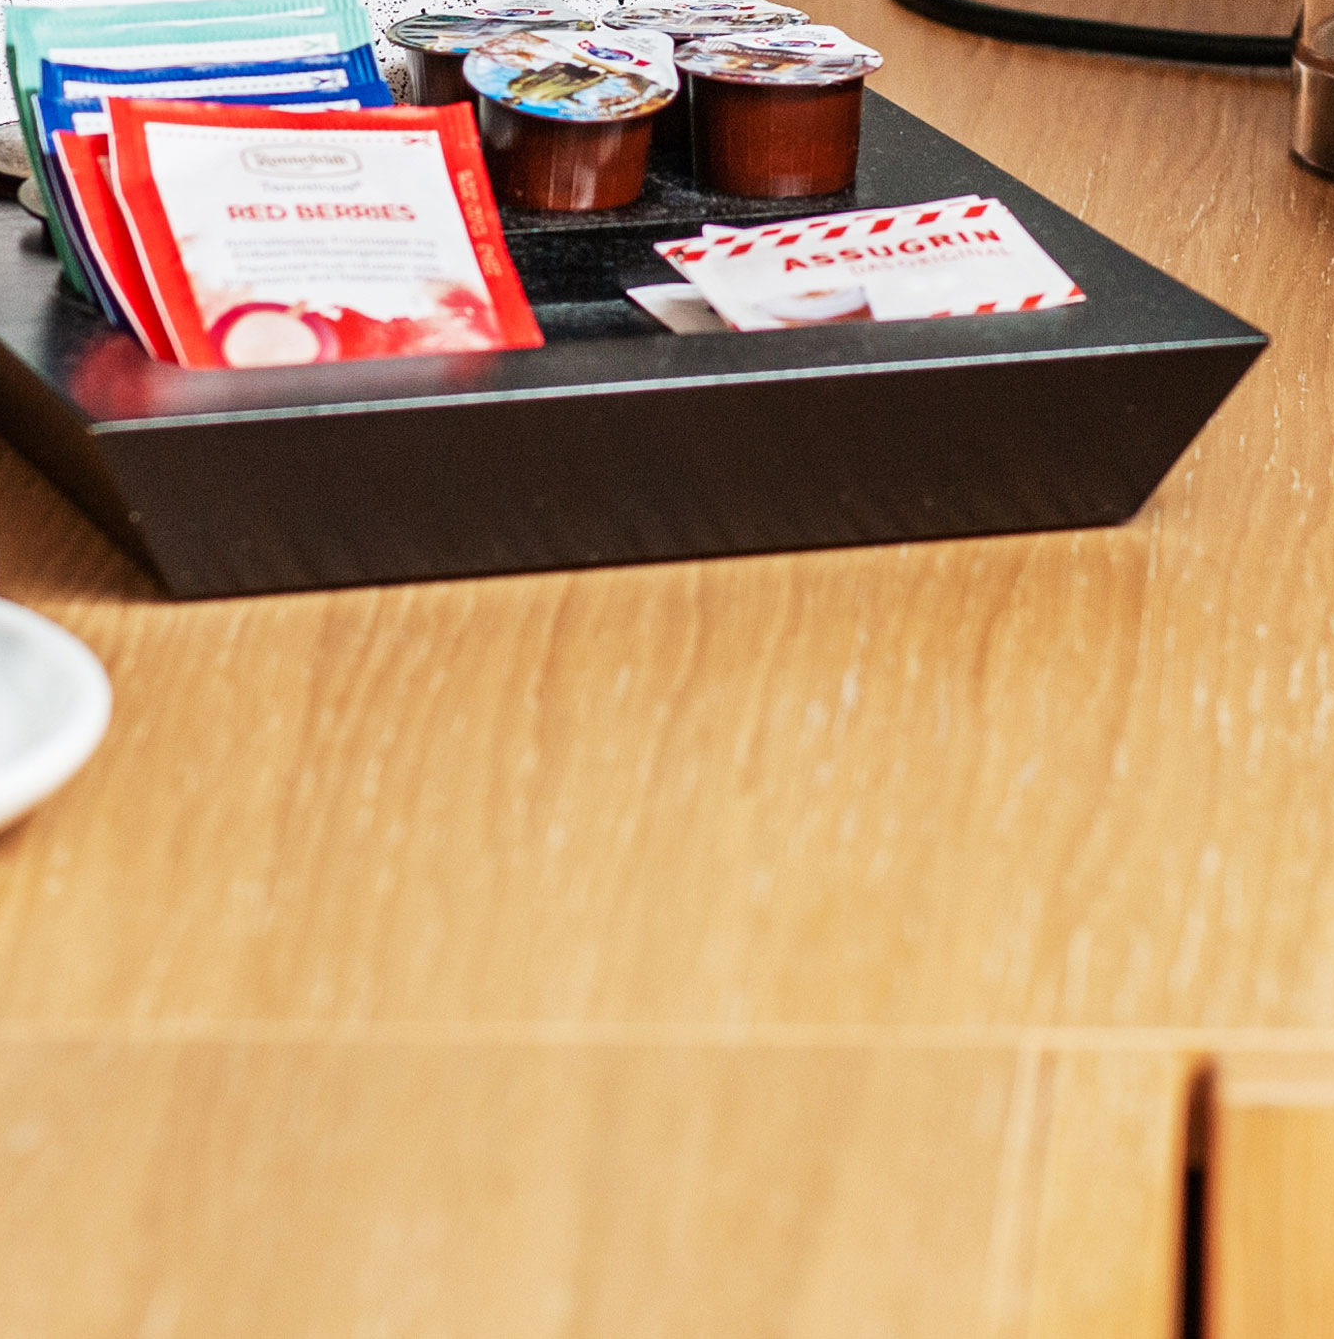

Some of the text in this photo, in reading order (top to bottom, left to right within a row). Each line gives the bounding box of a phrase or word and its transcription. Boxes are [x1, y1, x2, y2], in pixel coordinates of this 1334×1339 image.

[227, 202, 416, 221] RED BERRIES
[783, 229, 1001, 272] ASSUGRIN
